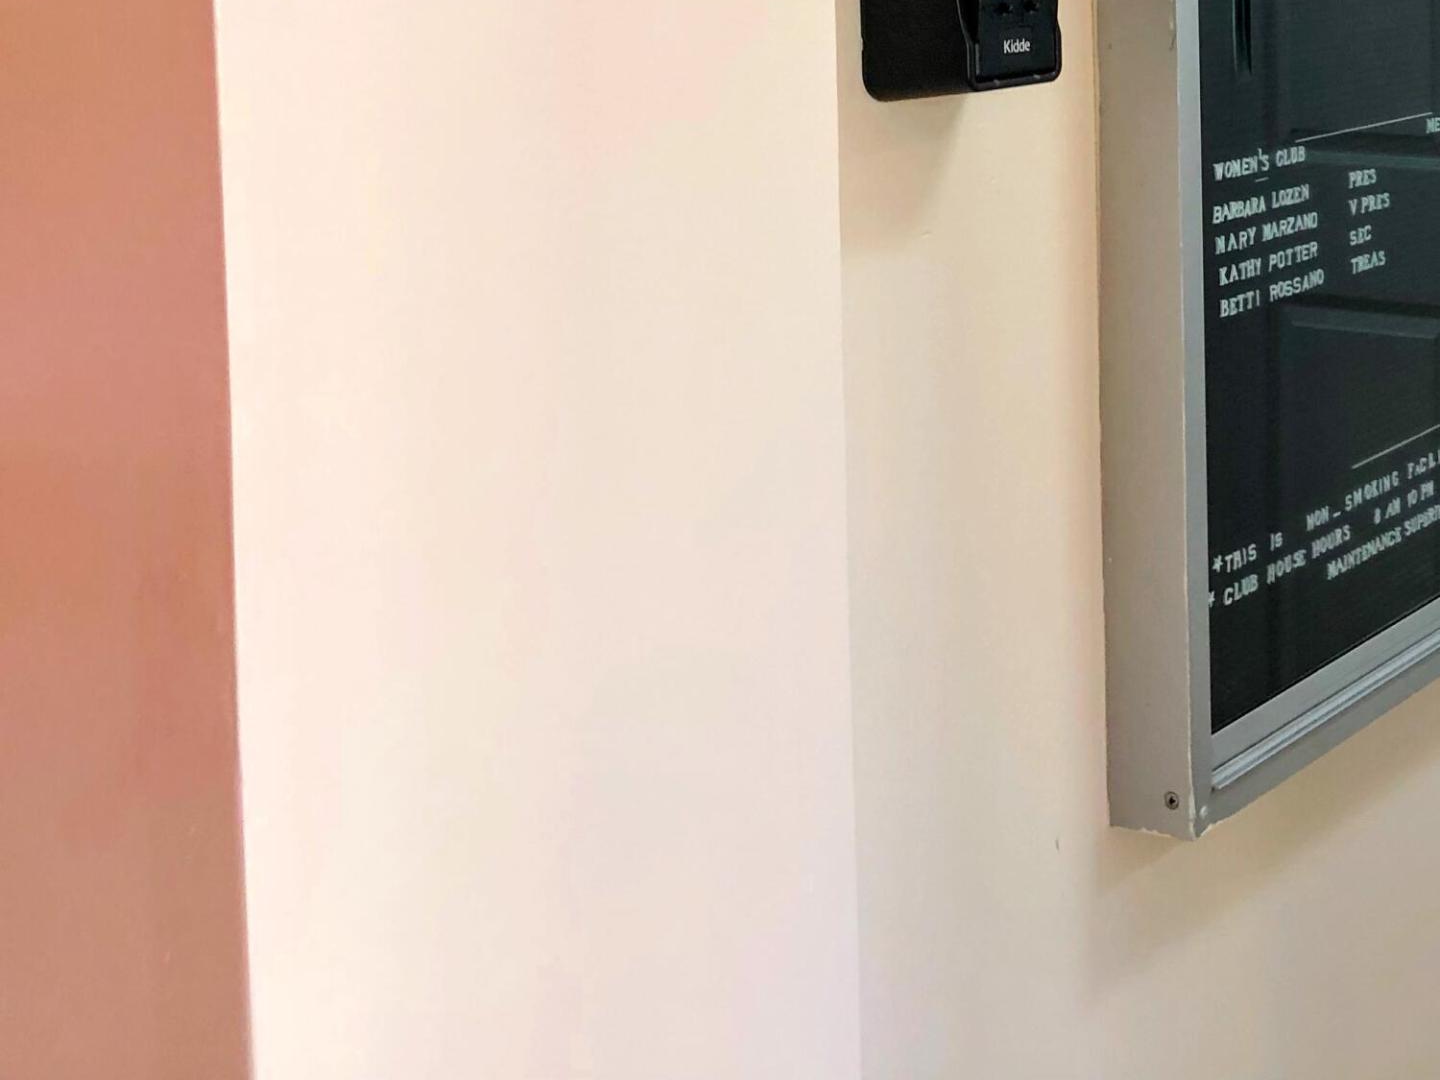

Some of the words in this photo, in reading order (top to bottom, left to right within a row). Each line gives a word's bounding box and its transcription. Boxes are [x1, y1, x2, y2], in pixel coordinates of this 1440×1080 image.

[1003, 38, 1031, 54] Kidde
[1213, 148, 1270, 182] WOMEN'S
[1276, 146, 1306, 168] CLUB
[1348, 168, 1377, 189] PRES
[1212, 195, 1267, 224] BARBARA
[1271, 184, 1310, 209] LOZEN
[1348, 199, 1357, 216] V
[1361, 192, 1390, 214] PRES
[1215, 226, 1257, 255] MARY
[1262, 211, 1318, 242] MARZANO
[1350, 225, 1372, 246] SEC
[1218, 256, 1262, 287] KATHY
[1269, 241, 1318, 273] POTTER
[1351, 250, 1386, 275] TREAS
[1219, 289, 1261, 318] BETTI
[1269, 268, 1325, 303] ROSSANO
[1270, 532, 1283, 552] IS
[1326, 526, 1402, 580] MAINTENANCE
[1222, 573, 1259, 606] CLUB
[1266, 548, 1307, 584] HOUSE
[1311, 524, 1351, 559] HOURS
